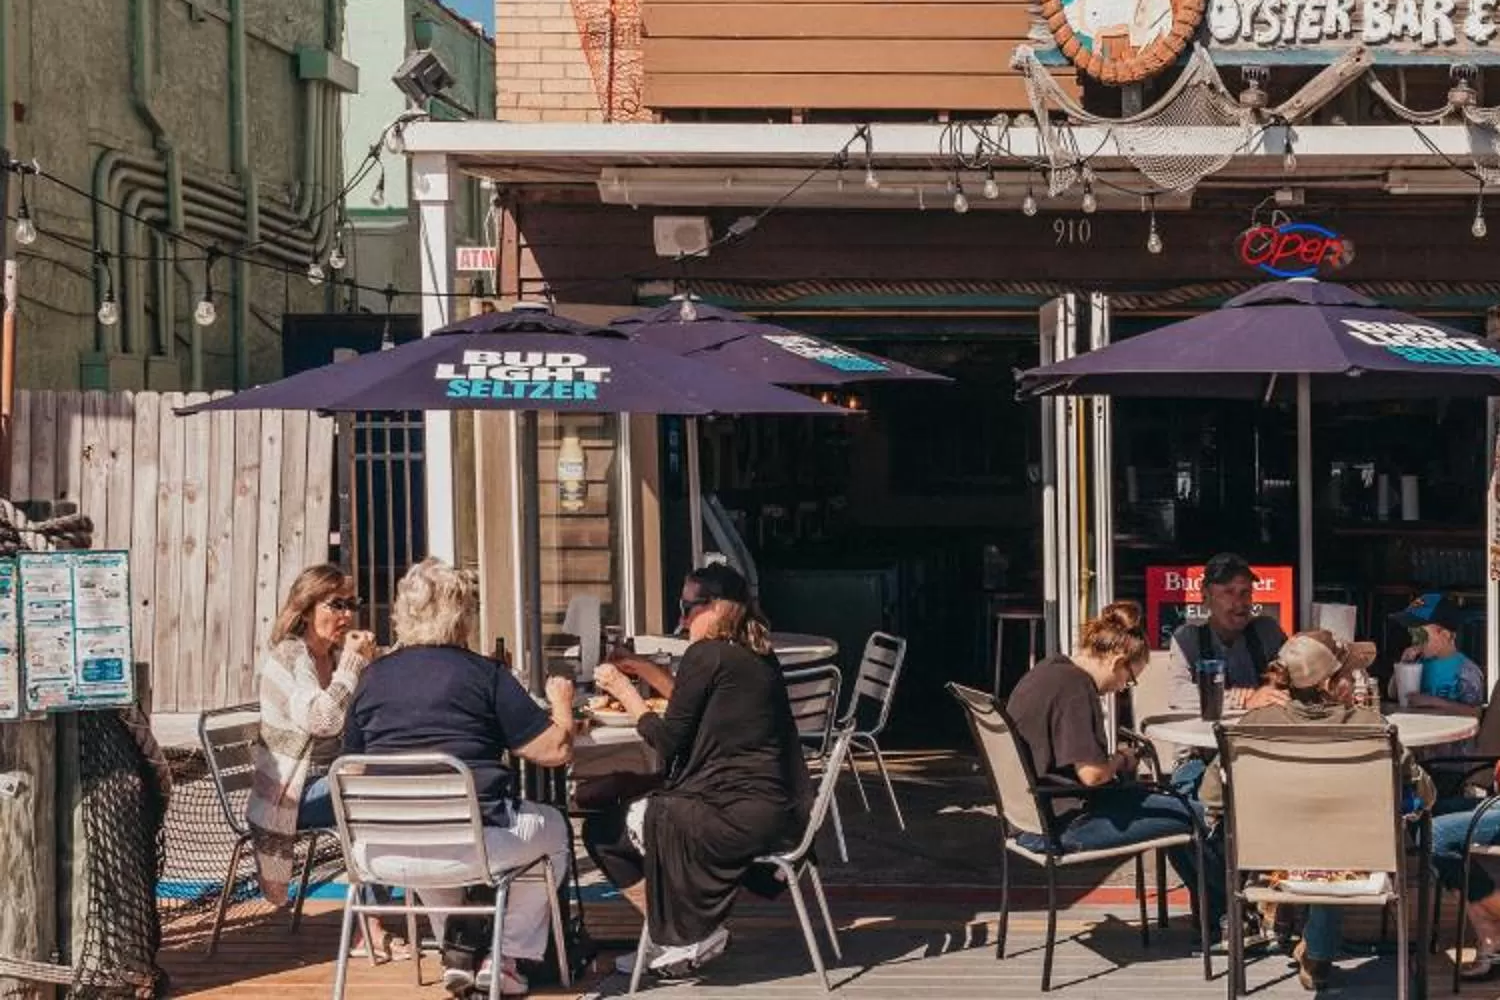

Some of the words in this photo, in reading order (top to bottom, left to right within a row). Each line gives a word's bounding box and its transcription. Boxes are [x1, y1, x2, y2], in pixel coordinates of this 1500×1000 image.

[1053, 218, 1091, 244] 910
[1242, 227, 1345, 268] Open
[460, 249, 496, 268] ATM
[463, 350, 588, 367] BUD
[435, 363, 611, 382] LIGHT
[447, 379, 598, 400] SELTZER
[1164, 571, 1276, 591] Buder
